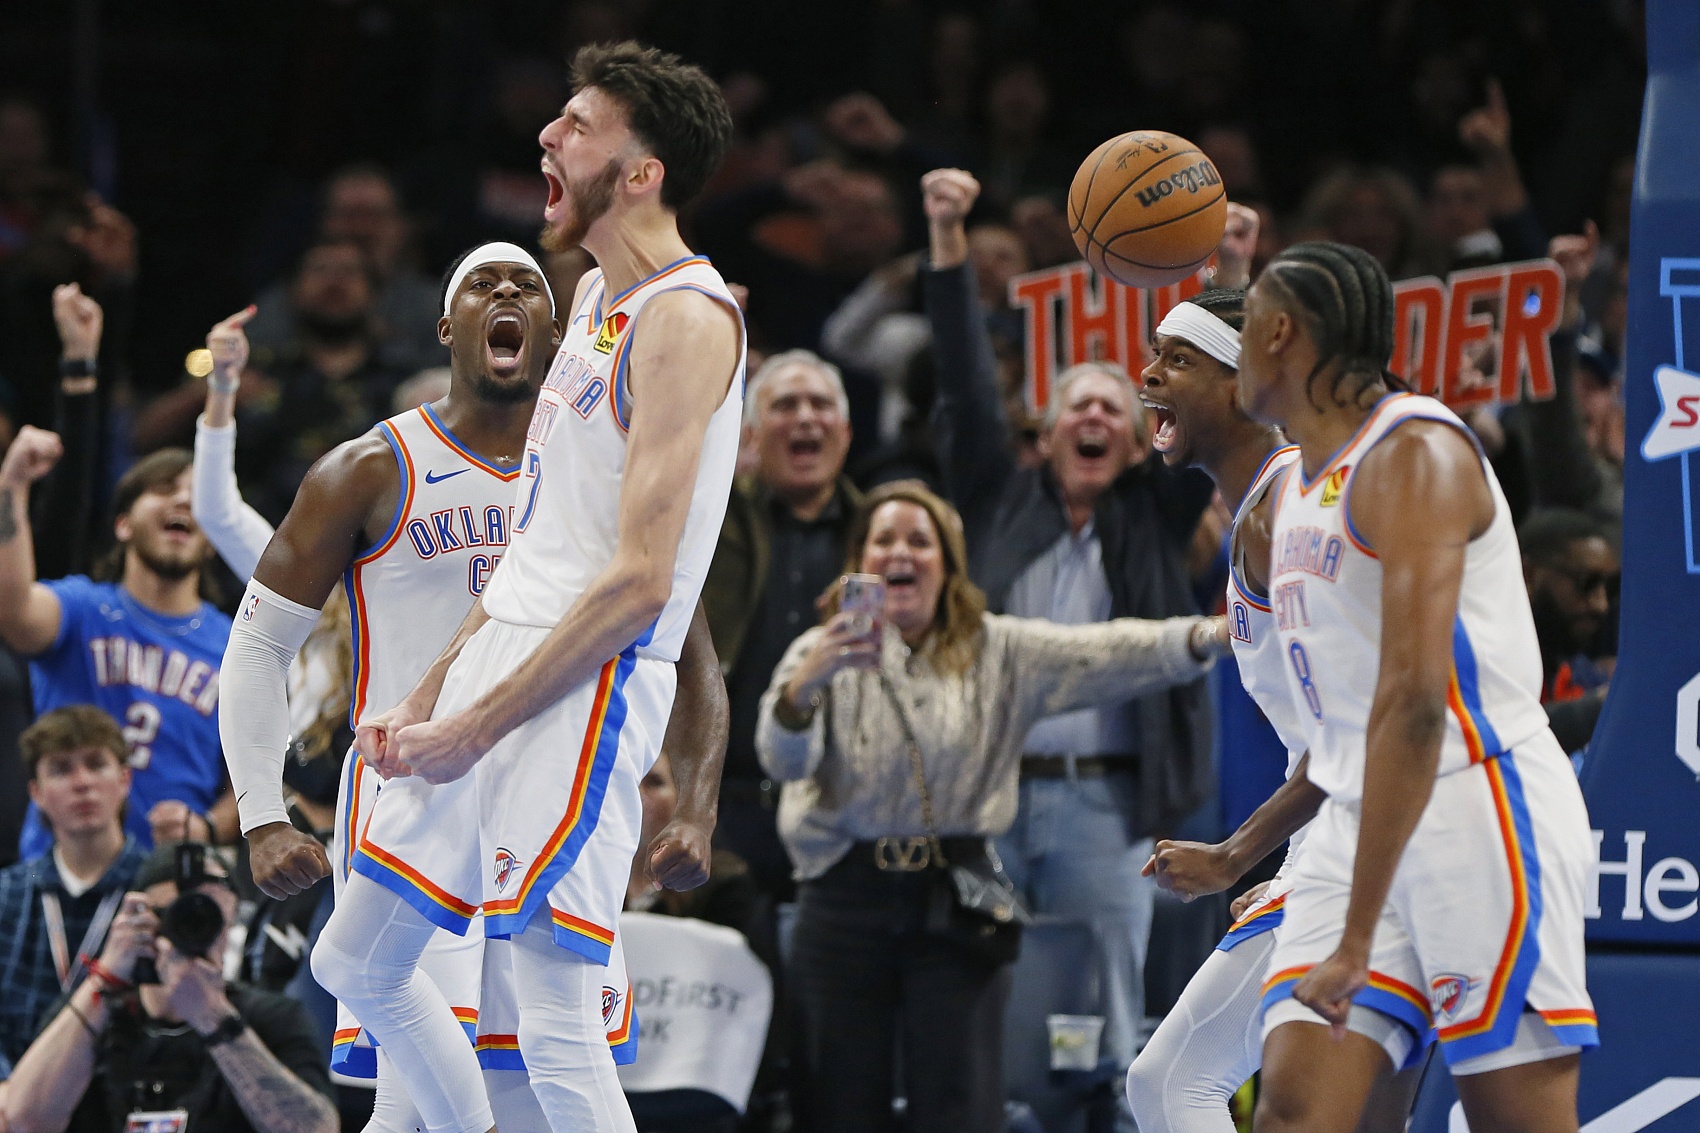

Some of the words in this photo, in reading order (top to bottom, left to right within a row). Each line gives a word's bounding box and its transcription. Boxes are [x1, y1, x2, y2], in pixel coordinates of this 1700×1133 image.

[1133, 160, 1221, 208] Wilson
[1008, 260, 1565, 418] THUDER
[512, 448, 543, 534] 7
[406, 504, 516, 560] OKLA
[1287, 636, 1324, 726] 8
[120, 700, 163, 770] 2
[633, 975, 748, 1016] DFIRST
